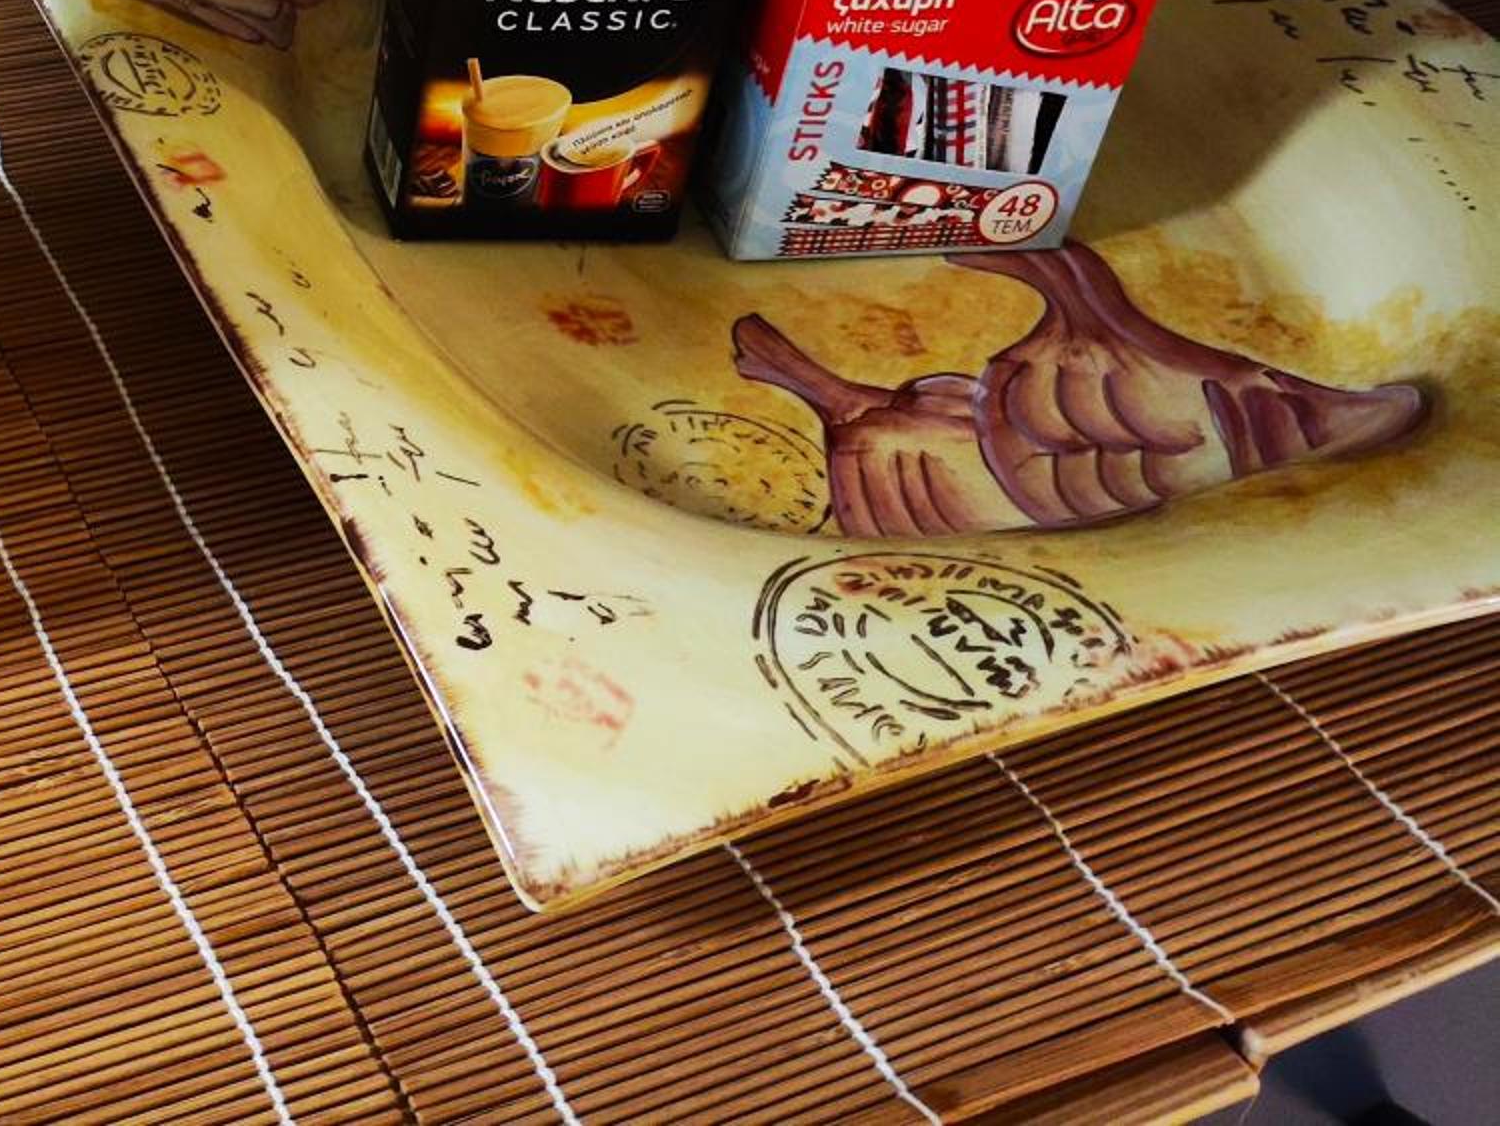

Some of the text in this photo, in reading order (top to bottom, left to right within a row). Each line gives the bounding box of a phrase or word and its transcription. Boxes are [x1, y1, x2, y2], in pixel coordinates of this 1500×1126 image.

[498, 9, 673, 32] CLASSIC
[827, 16, 949, 36] white sugar
[787, 60, 846, 162] STICKS
[997, 193, 1041, 217] 48
